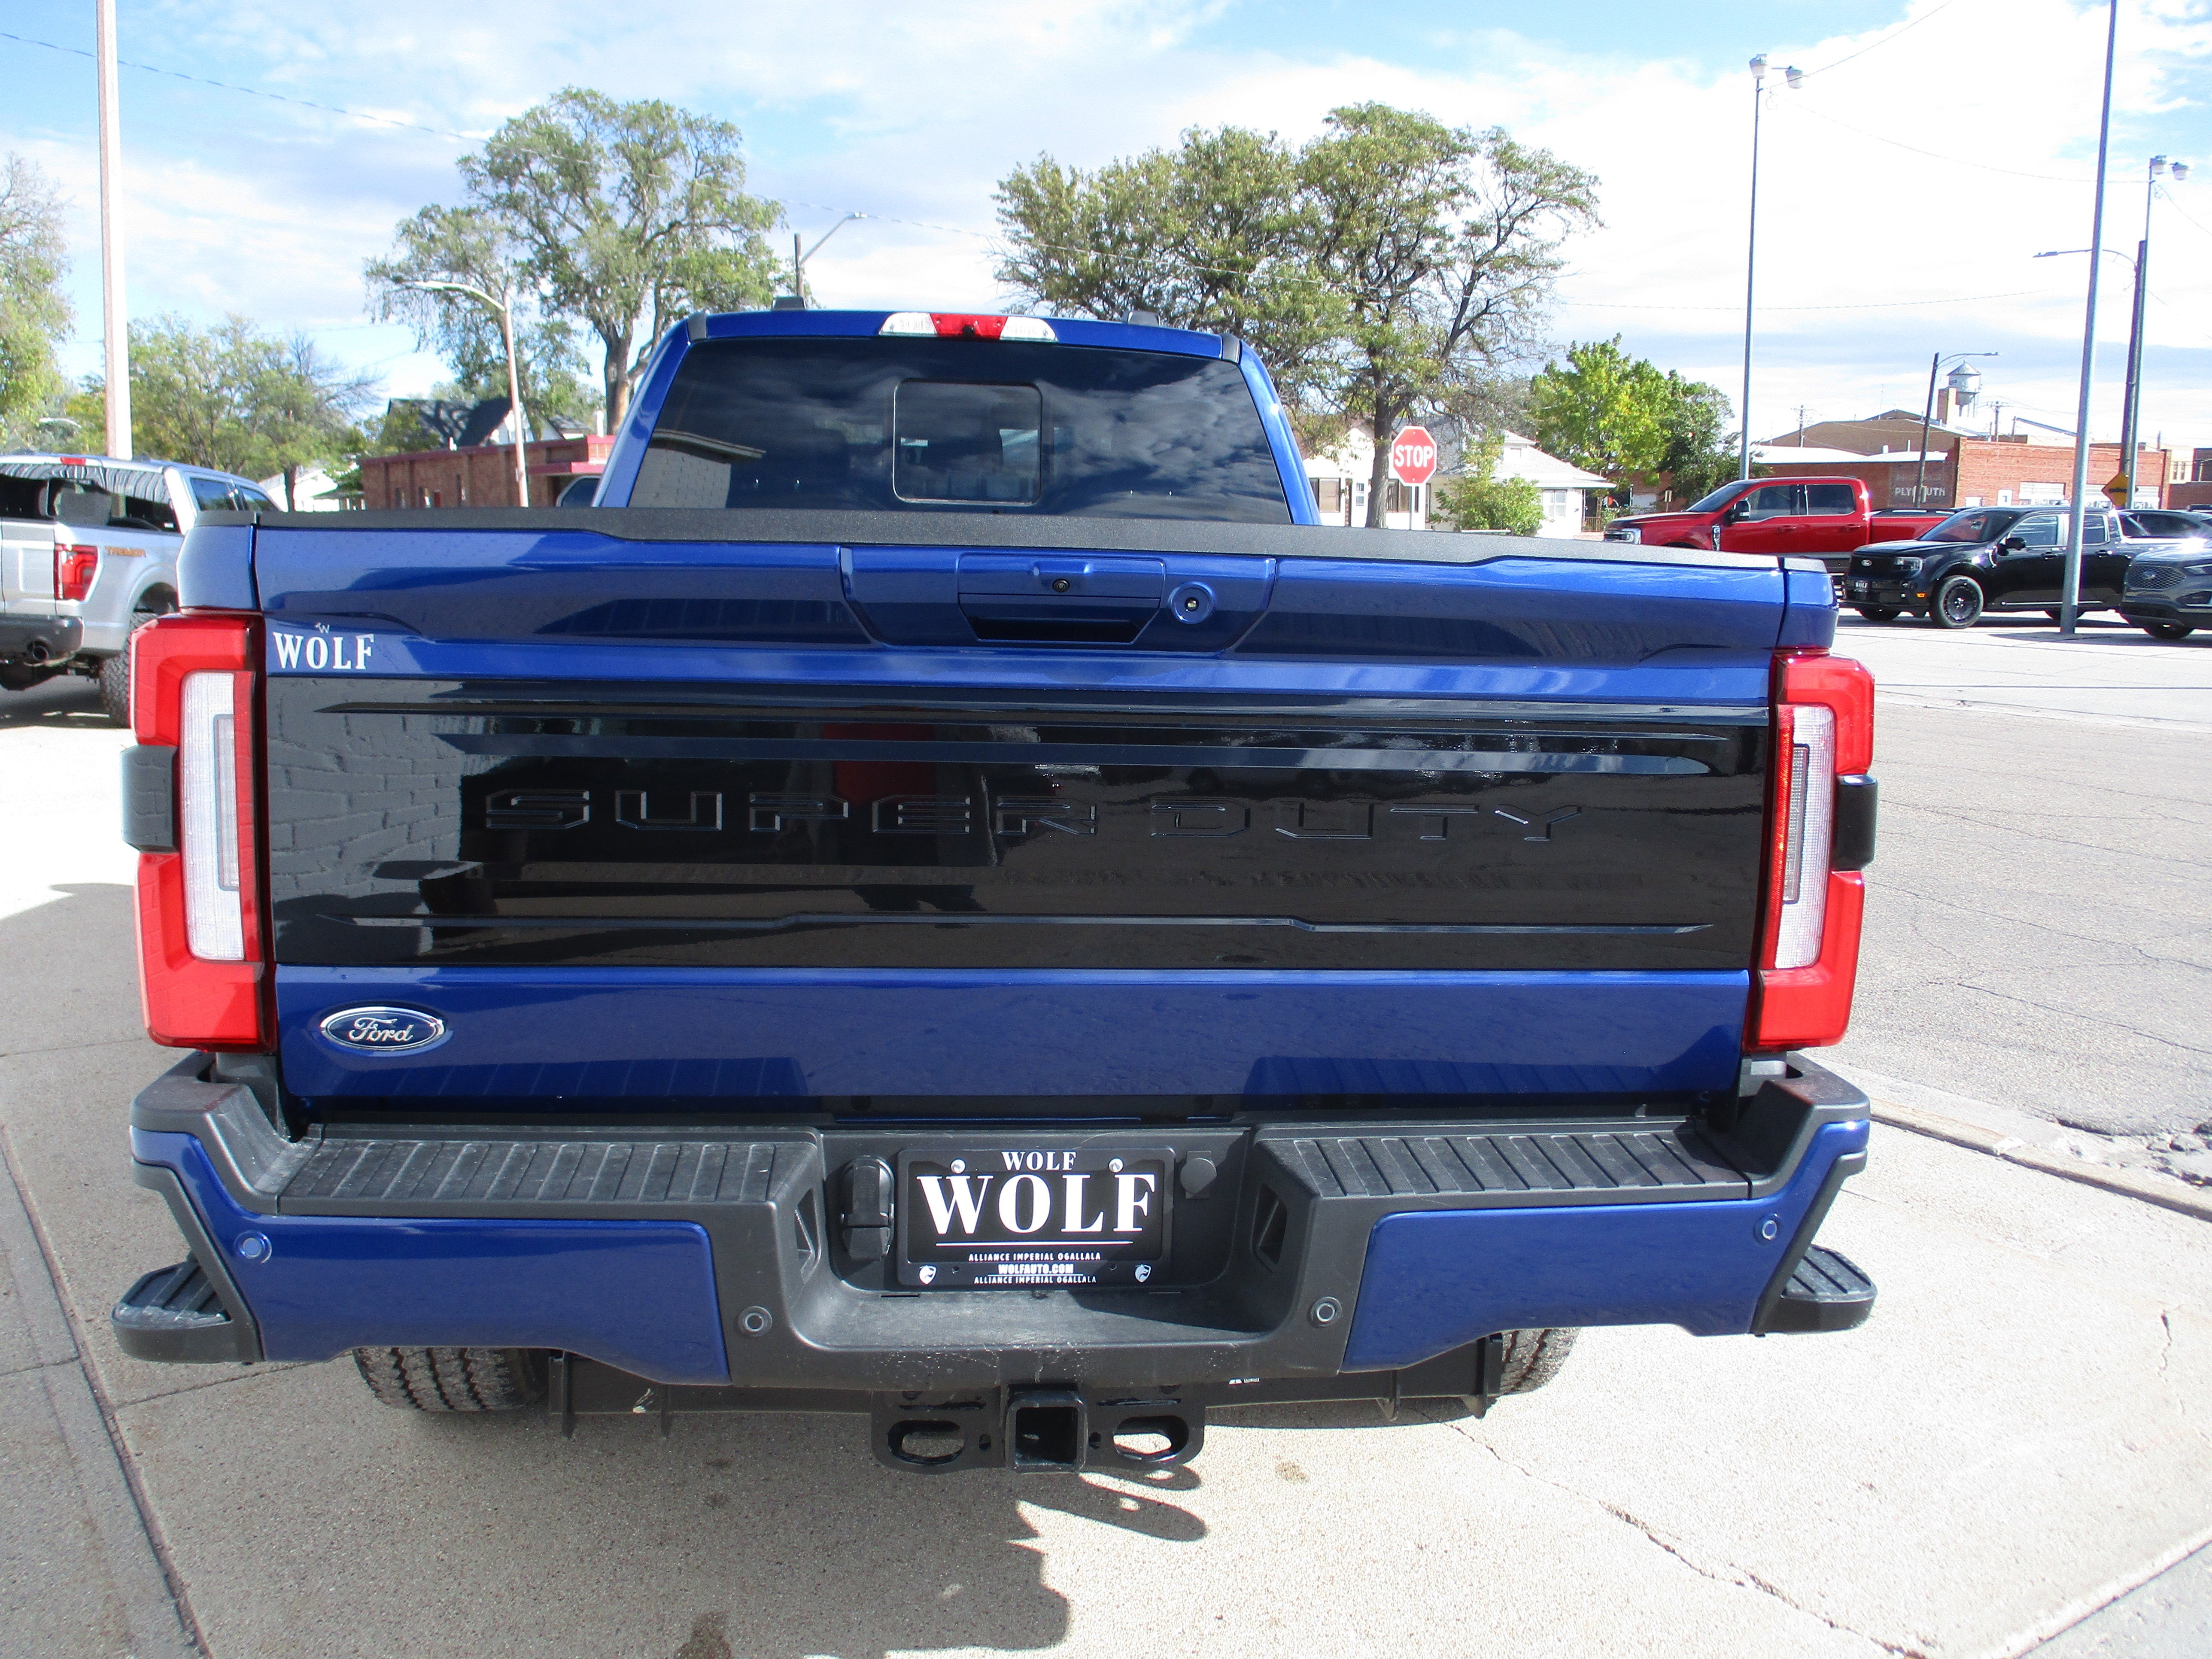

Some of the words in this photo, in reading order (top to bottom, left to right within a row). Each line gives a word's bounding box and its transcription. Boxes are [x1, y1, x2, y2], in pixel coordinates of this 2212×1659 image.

[1395, 444, 1433, 468] STOP
[1894, 486, 1945, 496] PLYUTH
[273, 632, 374, 669] WOLF
[486, 789, 1097, 836] SUPER
[1151, 797, 1582, 841] DUTY
[348, 1017, 413, 1042] Ford
[1001, 1152, 1076, 1171] WOLF
[916, 1174, 1155, 1234] WOLF
[968, 1253, 1010, 1262] ALLIANCE
[1013, 1252, 1054, 1261] IMPERIAL
[1057, 1252, 1101, 1261] OGALLALA
[998, 1264, 1074, 1275] WOLFAUTO.COM
[974, 1276, 1012, 1285] ALLIANCE
[1015, 1276, 1053, 1284] IMPERIAL
